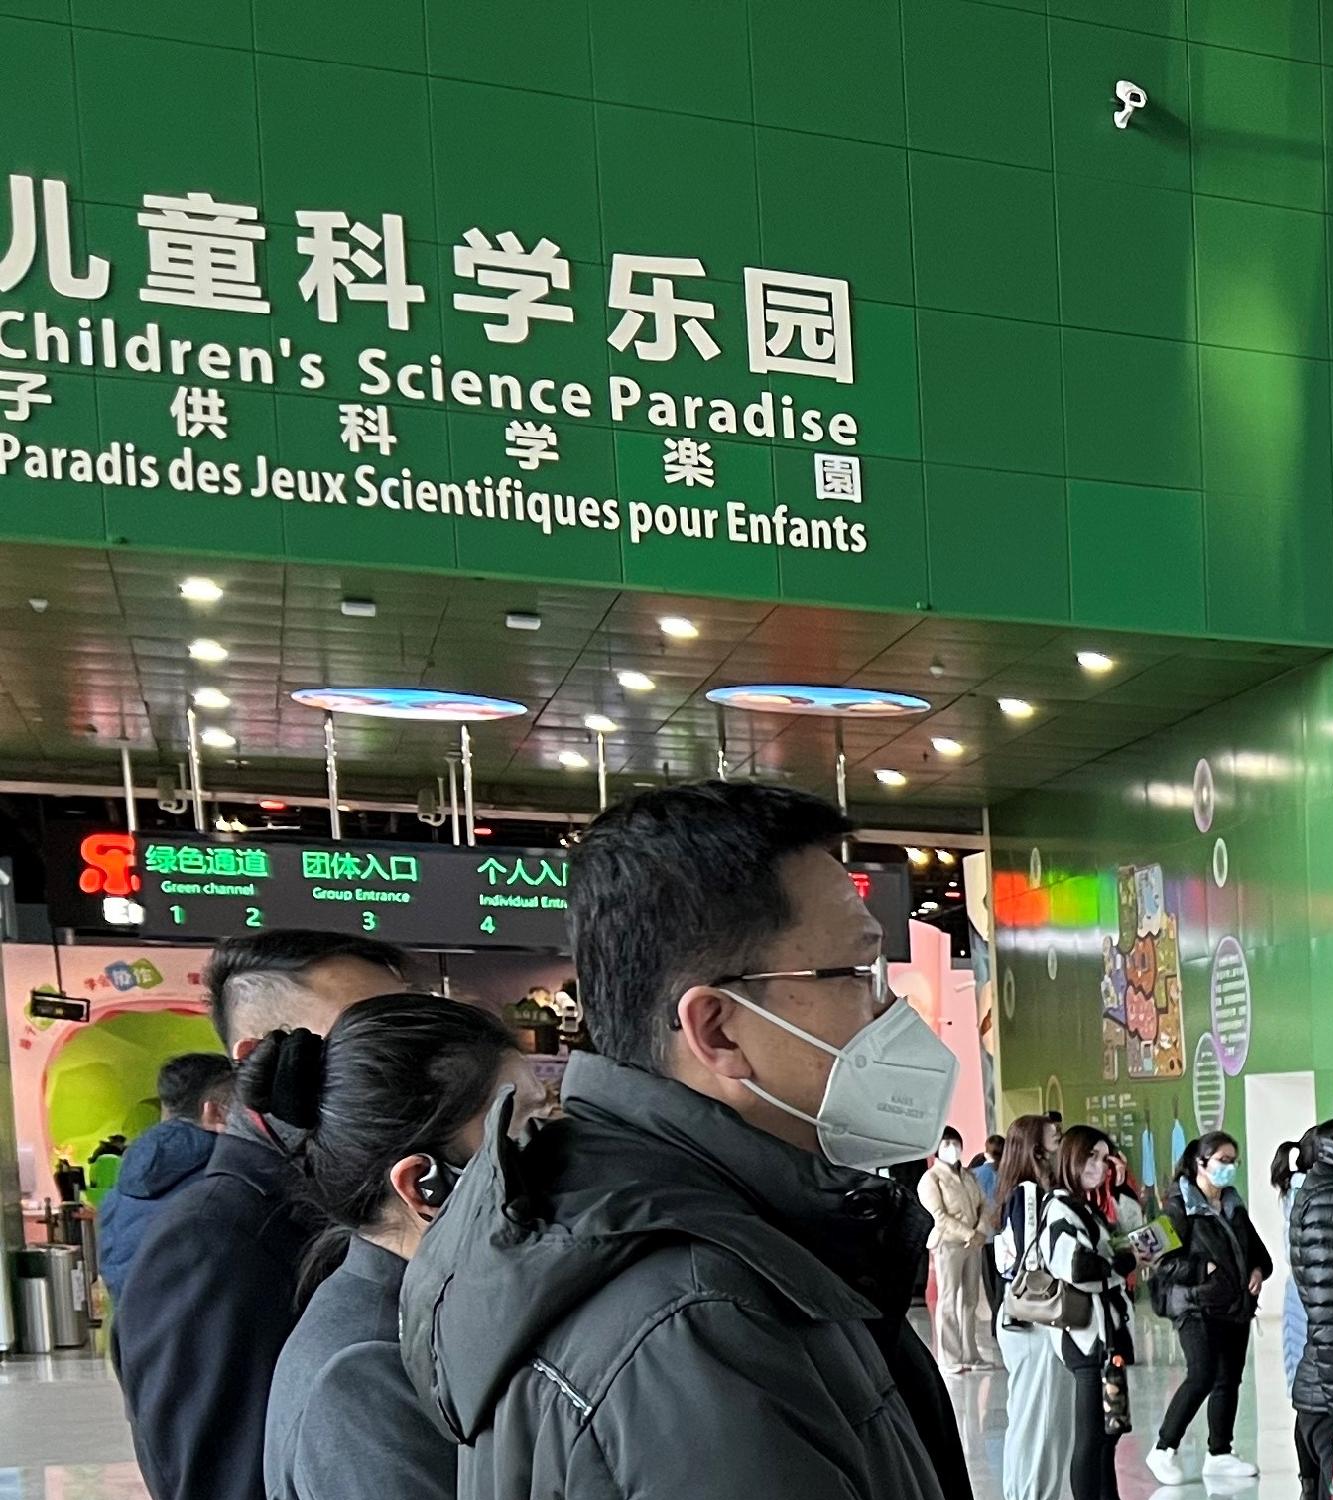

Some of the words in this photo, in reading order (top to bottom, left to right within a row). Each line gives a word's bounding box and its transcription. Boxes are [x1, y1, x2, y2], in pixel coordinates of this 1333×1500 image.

[0, 174, 855, 385] 儿童科学乐园
[0, 310, 325, 389] Children's
[357, 347, 592, 418] Science
[609, 375, 858, 447] Paradise
[0, 432, 160, 488] Paradis
[168, 446, 243, 496] des
[250, 455, 348, 505] Jeux
[354, 464, 621, 535] Scientifiques
[628, 500, 719, 544] pour
[726, 500, 868, 553] Enfants
[144, 844, 271, 878] 绿色通道
[301, 850, 419, 882] 团体入口
[477, 857, 569, 887] 个人入
[160, 880, 201, 895] Green
[203, 881, 255, 897] channel
[311, 886, 353, 902] Group
[354, 888, 411, 903] Entrance
[479, 894, 539, 908] Individual
[170, 905, 183, 924] 1
[245, 907, 262, 927] 2
[361, 910, 377, 931] 3
[480, 915, 496, 934] 4
